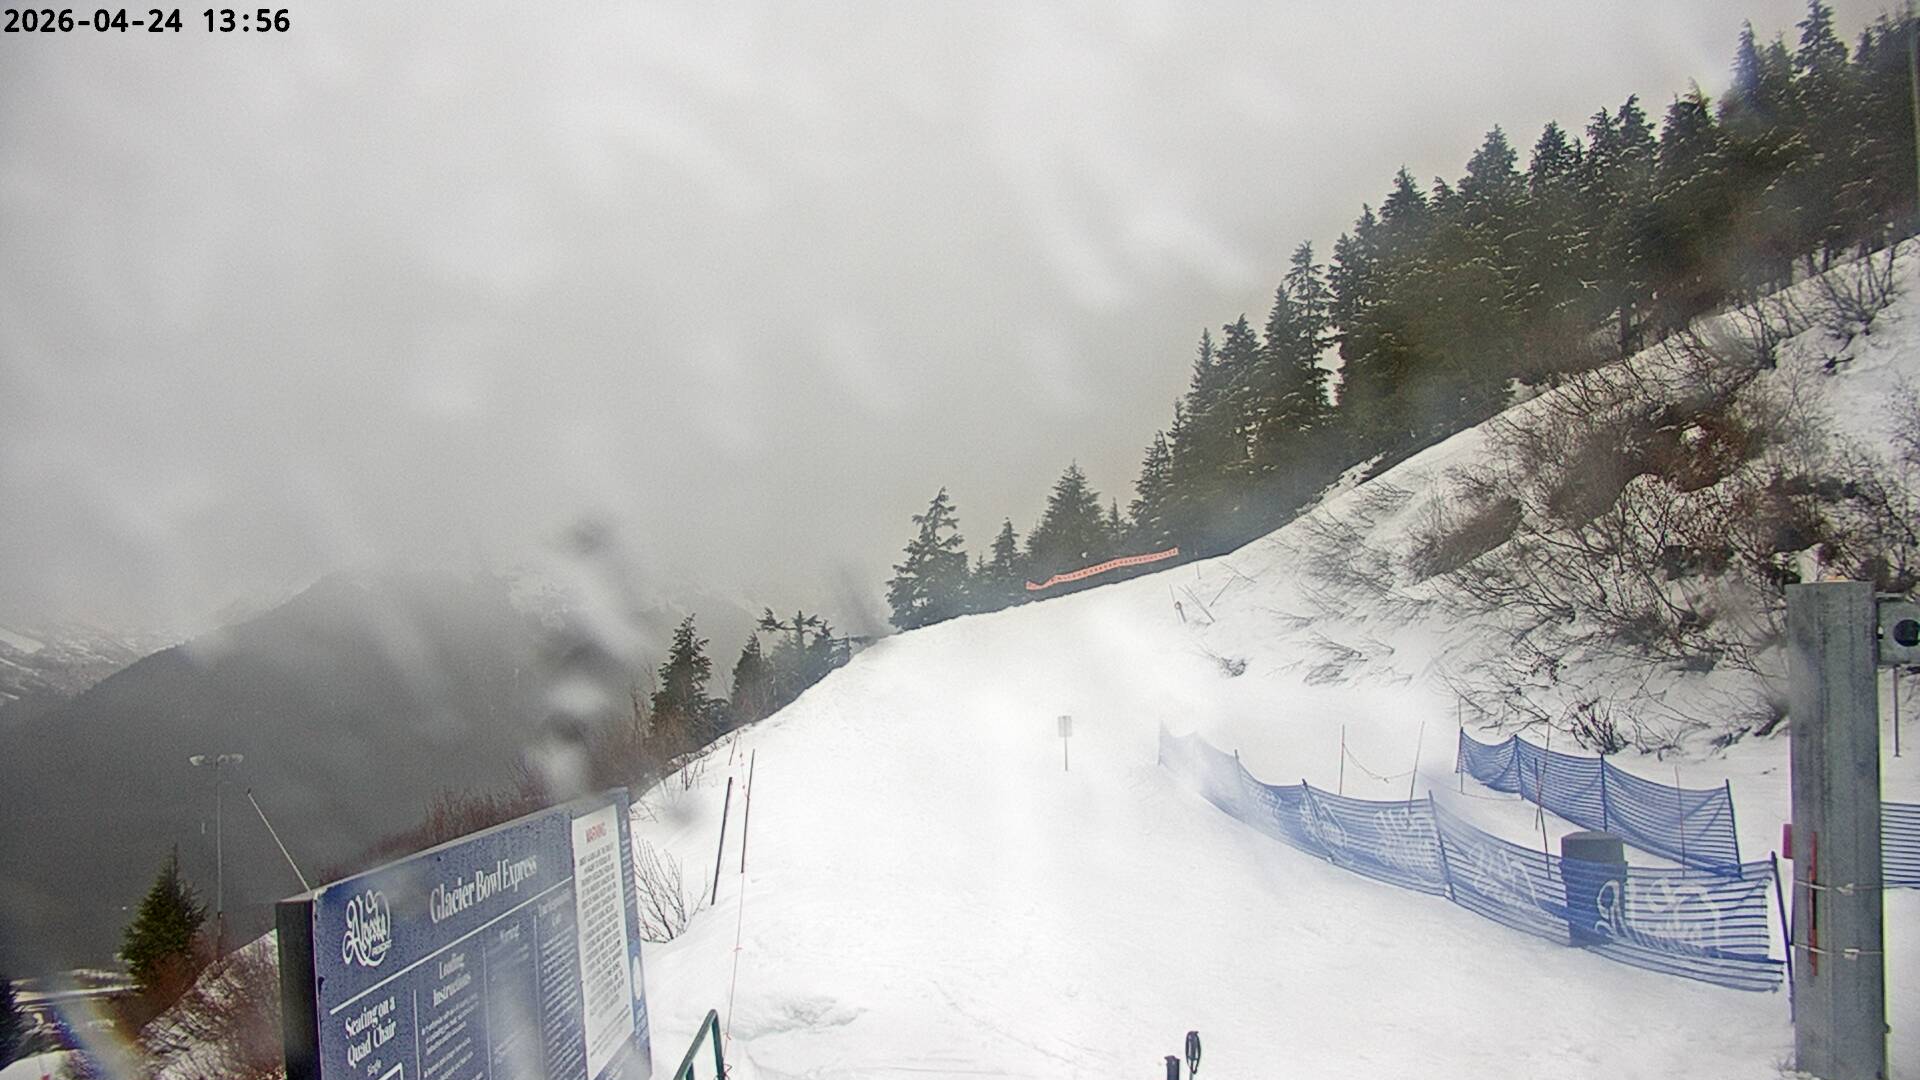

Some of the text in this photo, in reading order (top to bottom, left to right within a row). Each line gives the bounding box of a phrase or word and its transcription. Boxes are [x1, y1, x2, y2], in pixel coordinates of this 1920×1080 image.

[430, 876, 475, 924] Glacier
[475, 860, 502, 903] Bowl
[502, 855, 537, 892] Express
[345, 1006, 379, 1040] Seating
[378, 999, 389, 1018] on
[347, 1031, 372, 1069] Quad
[373, 1018, 397, 1048] Chair
